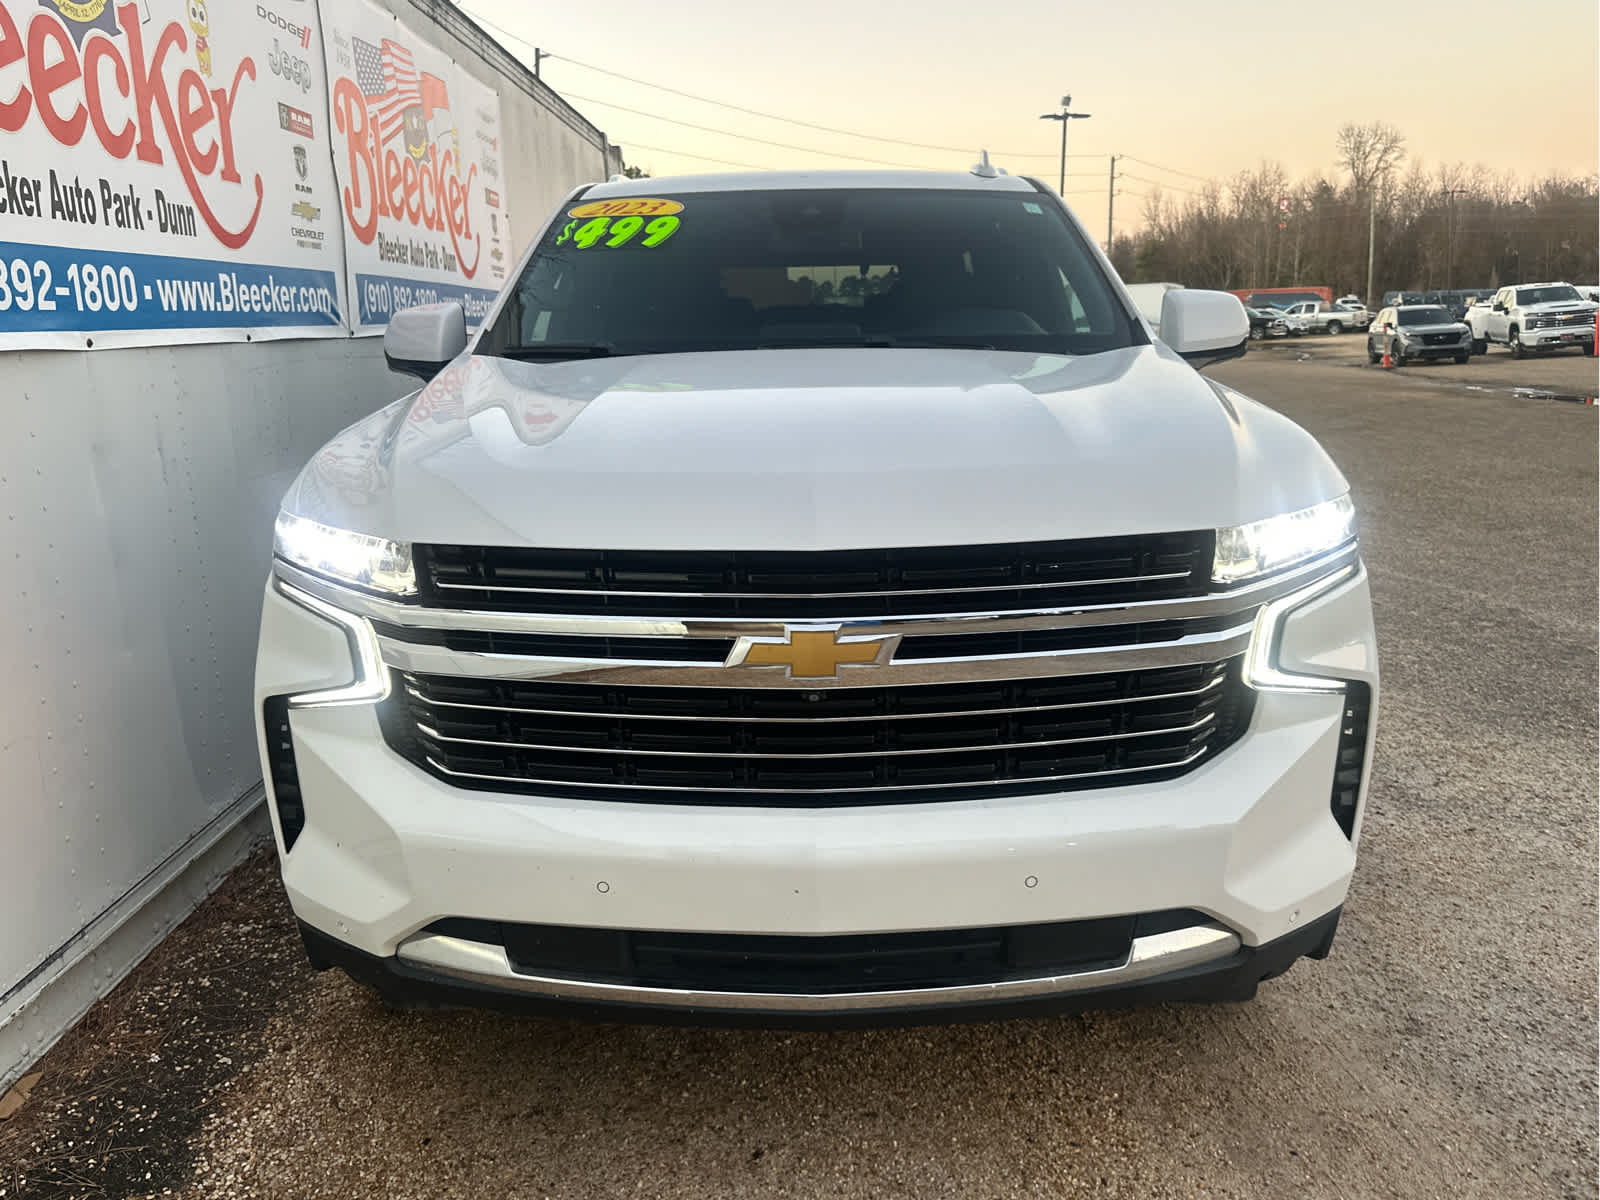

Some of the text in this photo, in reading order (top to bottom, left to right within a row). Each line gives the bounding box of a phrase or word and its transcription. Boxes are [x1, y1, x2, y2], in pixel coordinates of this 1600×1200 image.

[256, 5, 305, 40] DODGE
[268, 38, 312, 94] Jeep
[291, 111, 311, 126] RAM
[295, 183, 313, 194] RAM
[333, 76, 481, 280] Bleecker
[49, 169, 97, 225] Auto
[99, 178, 145, 231] Park
[155, 189, 198, 237] Dunn
[583, 201, 668, 216] 2023
[377, 231, 409, 265] Bleecker
[424, 241, 440, 270] Park
[556, 216, 681, 249] $499
[156, 272, 333, 314] www.Bleecker.com
[364, 279, 393, 320] (910)
